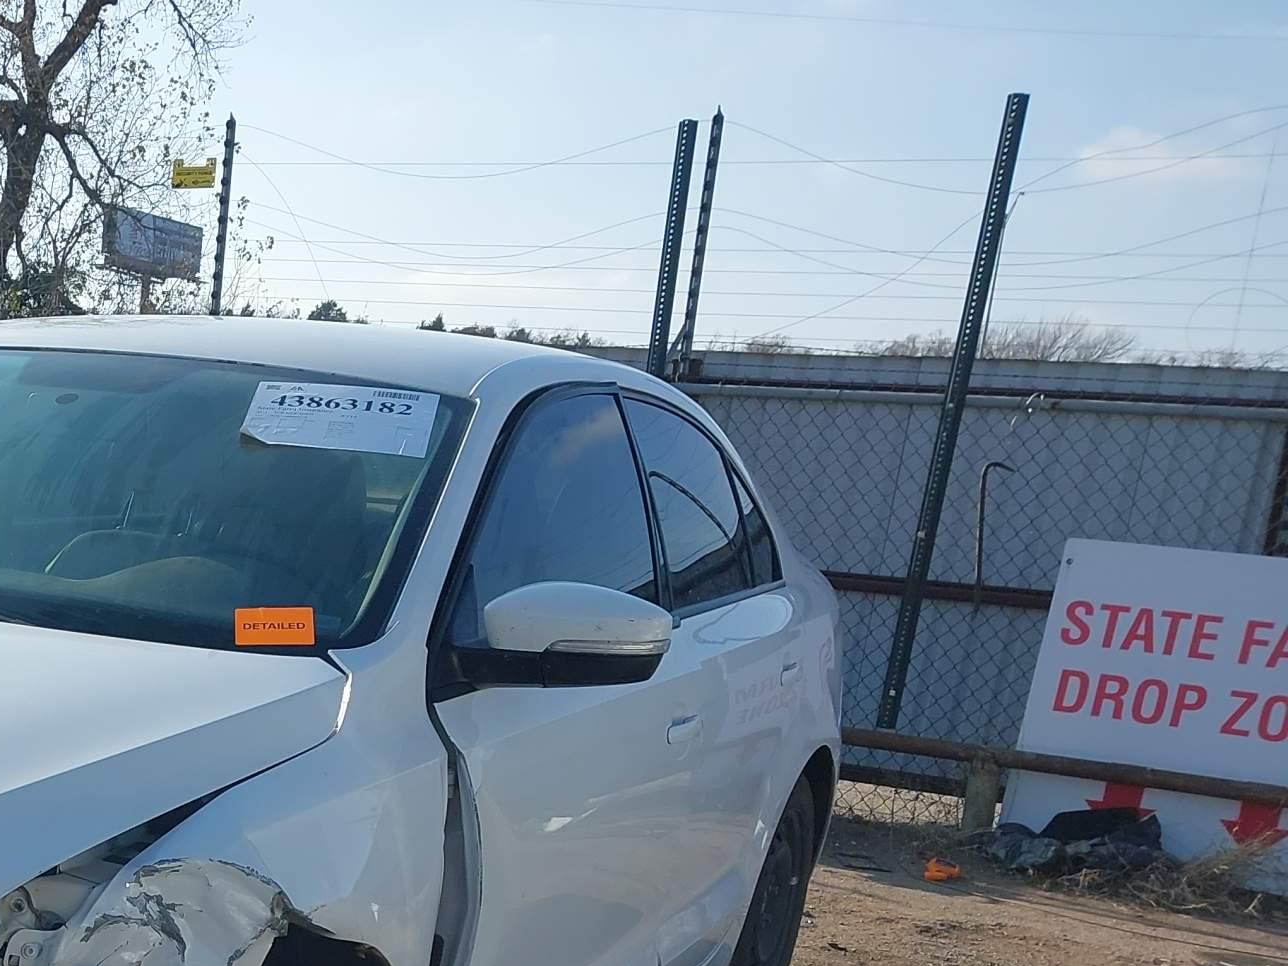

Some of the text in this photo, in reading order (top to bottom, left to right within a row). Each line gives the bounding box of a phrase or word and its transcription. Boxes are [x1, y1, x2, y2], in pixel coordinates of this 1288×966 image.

[271, 394, 414, 416] 43863182
[243, 622, 306, 630] DETAILED
[1060, 600, 1224, 660] STATE
[1052, 669, 1288, 742] DROP ZO
